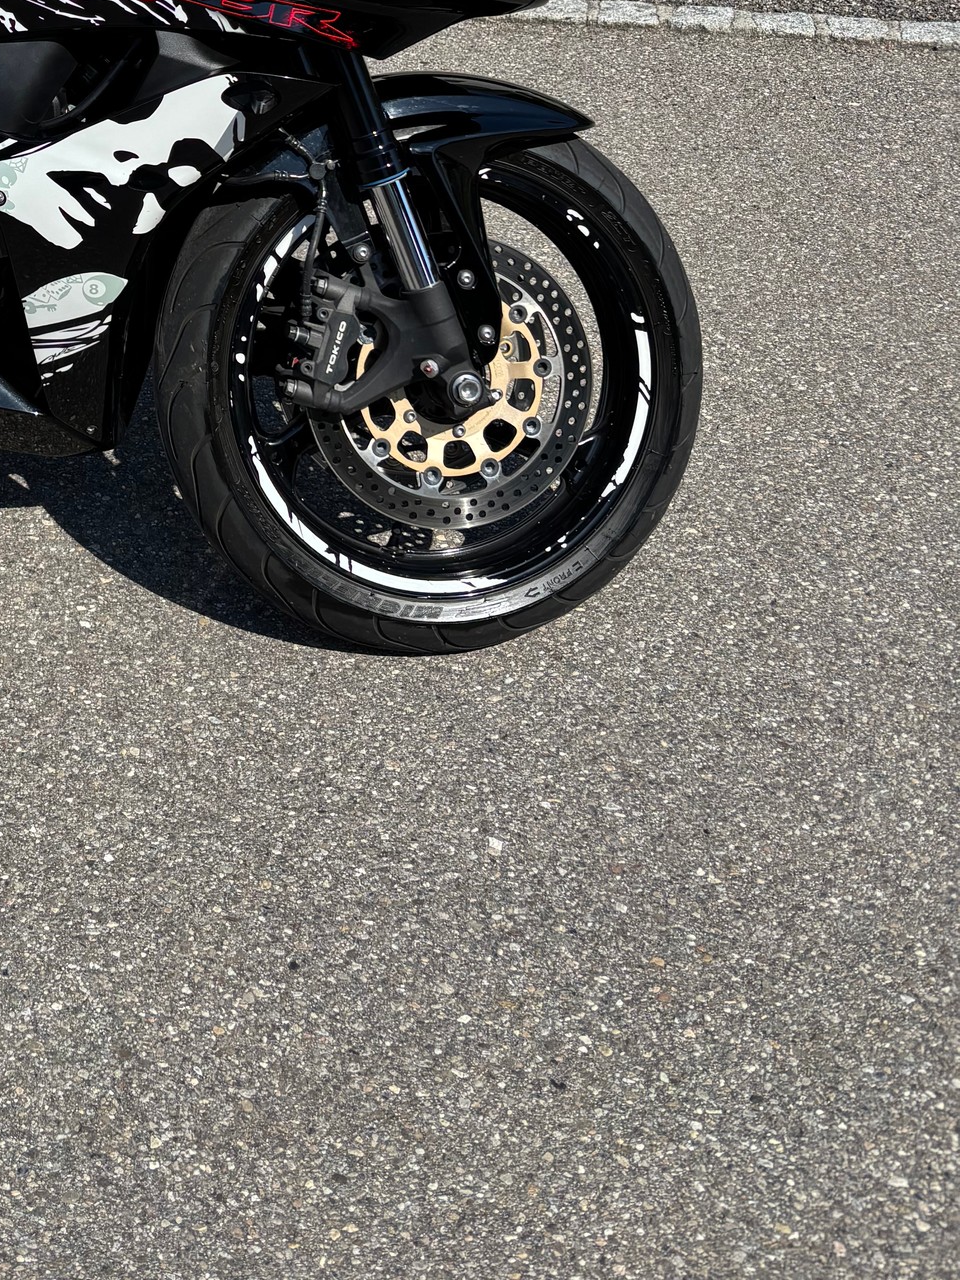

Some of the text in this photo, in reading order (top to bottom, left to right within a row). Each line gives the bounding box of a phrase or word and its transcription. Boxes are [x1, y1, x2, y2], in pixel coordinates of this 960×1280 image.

[89, 283, 99, 295] 8
[326, 321, 347, 374] TOKICO
[541, 568, 574, 593] FRONT
